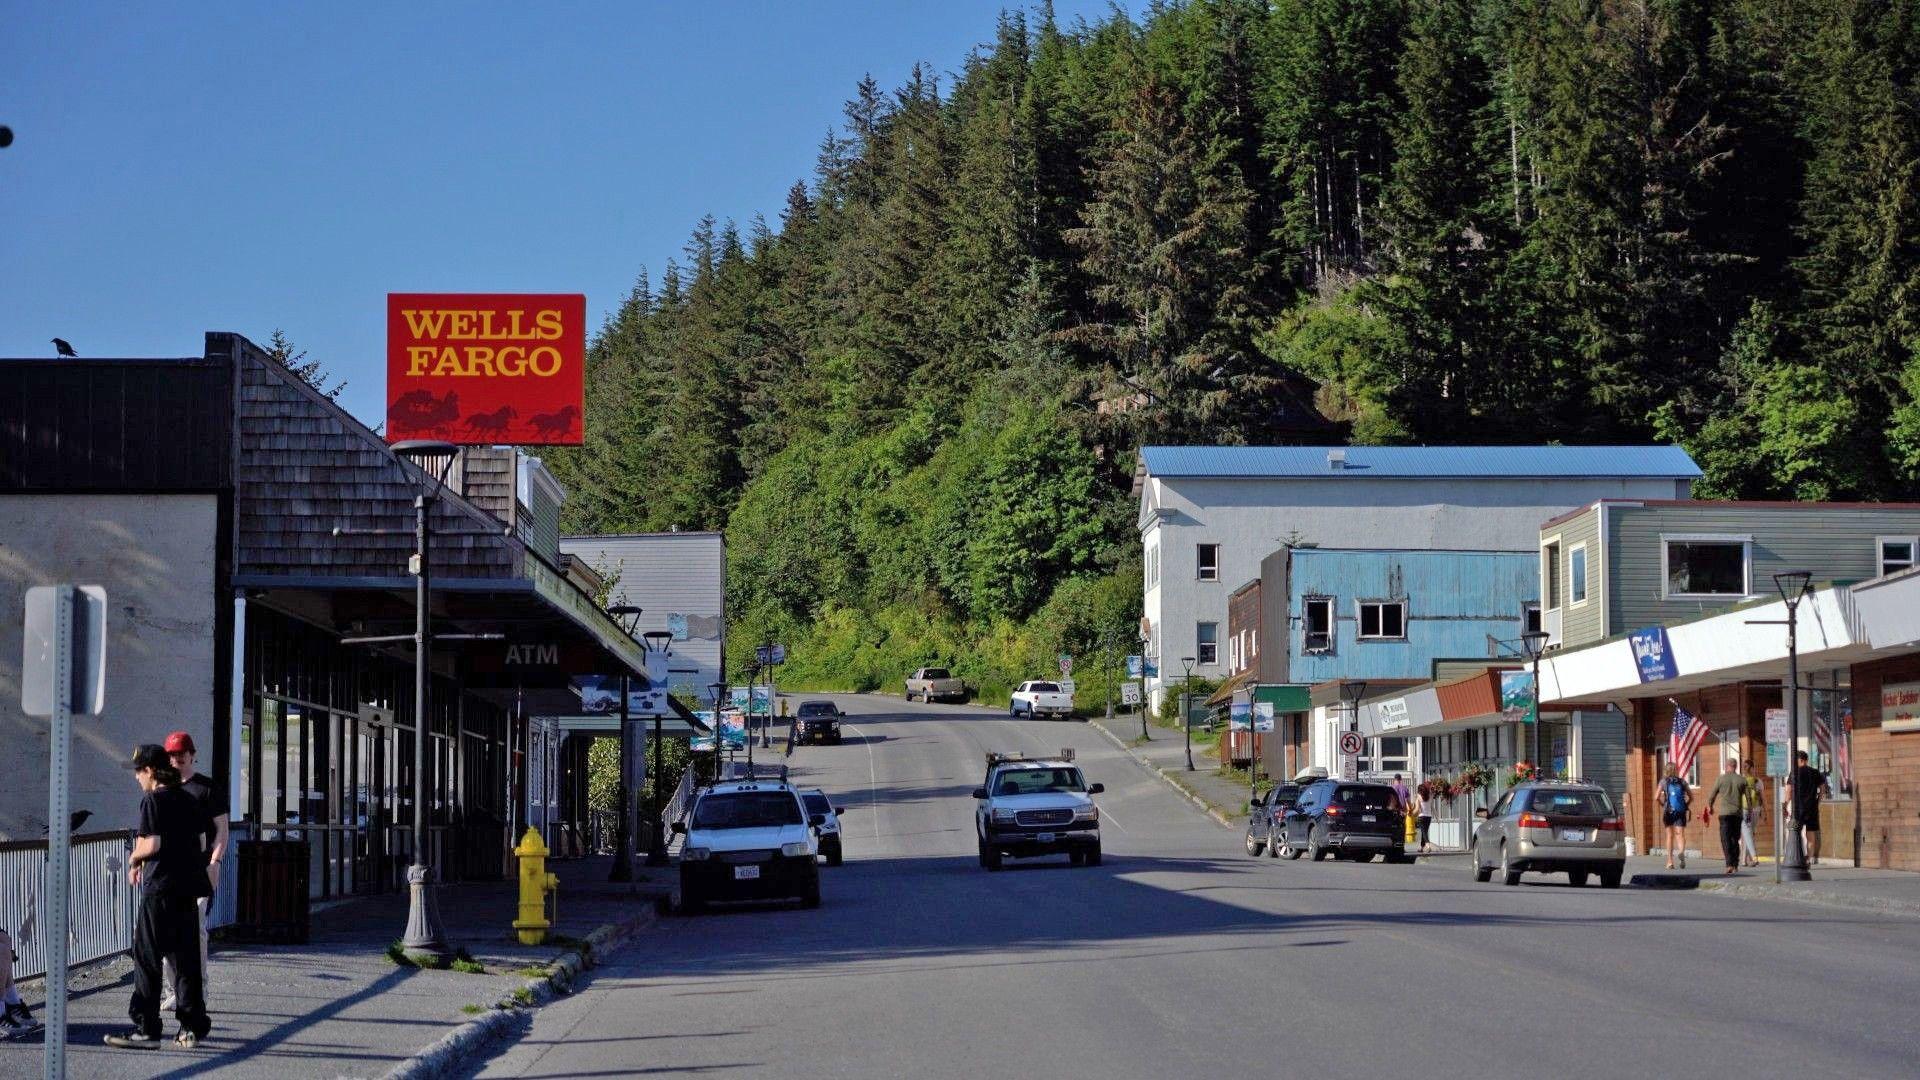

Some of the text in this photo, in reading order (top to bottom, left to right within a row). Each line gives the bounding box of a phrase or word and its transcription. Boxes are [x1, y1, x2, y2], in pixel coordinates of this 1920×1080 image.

[402, 310, 563, 340] WELLS
[406, 346, 562, 377] FARGO
[505, 644, 558, 665] ATM
[1125, 693, 1138, 702] 30
